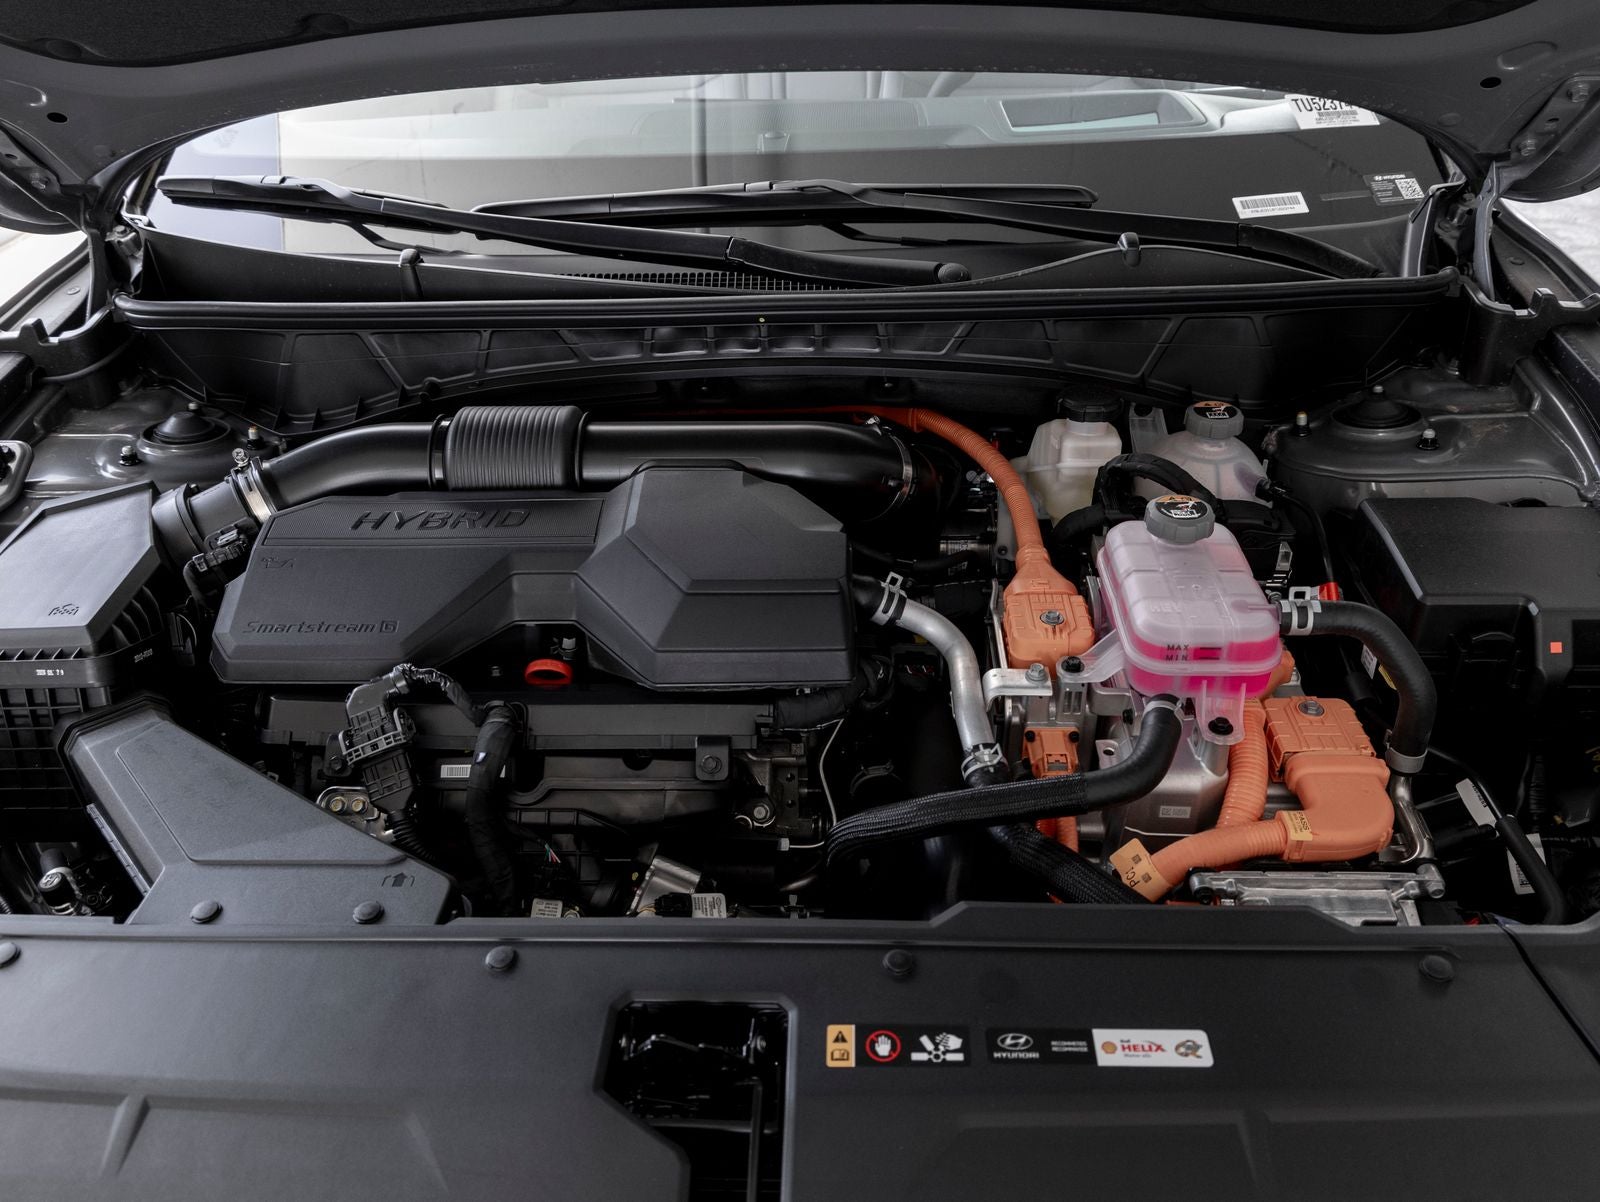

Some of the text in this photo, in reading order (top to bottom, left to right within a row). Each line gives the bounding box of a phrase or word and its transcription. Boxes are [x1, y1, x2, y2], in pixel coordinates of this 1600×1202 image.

[350, 508, 530, 532] HYBRID
[242, 620, 376, 634] Smartstream
[1167, 643, 1189, 651] MAX
[1121, 1044, 1167, 1053] HELIX
[993, 1051, 1040, 1059] HYUNDAI
